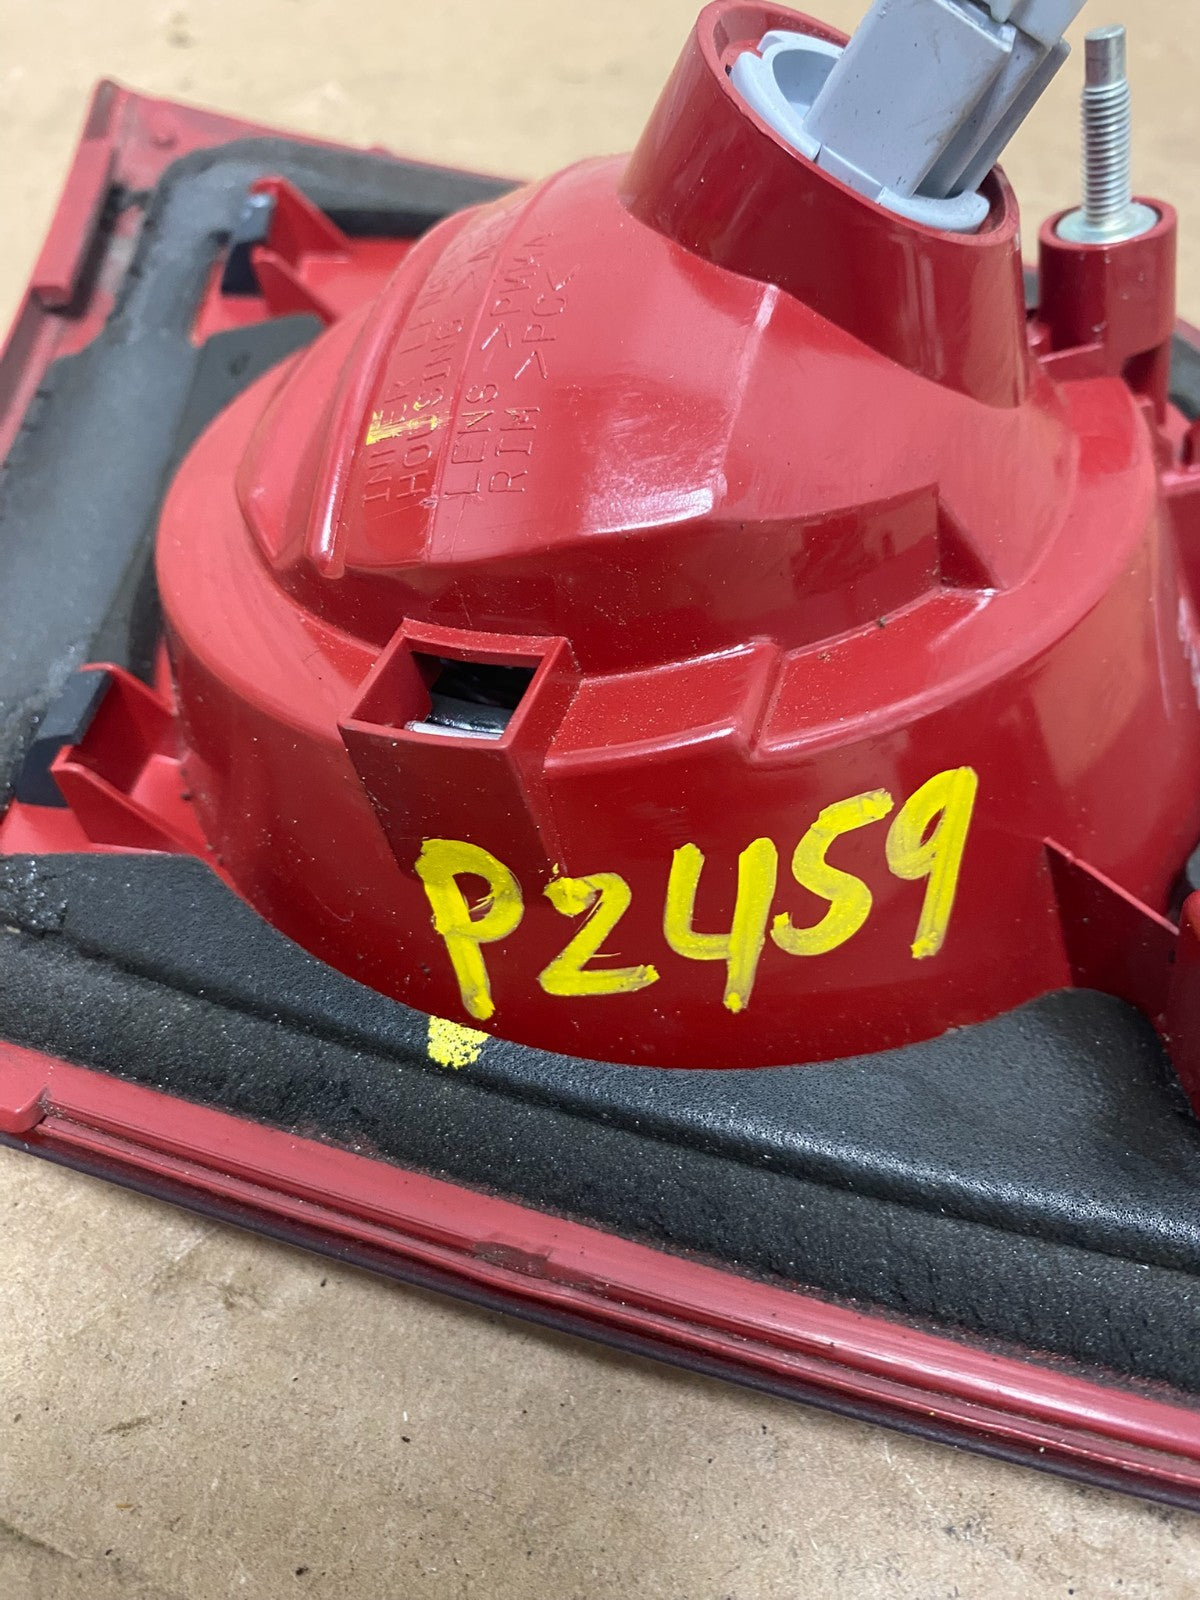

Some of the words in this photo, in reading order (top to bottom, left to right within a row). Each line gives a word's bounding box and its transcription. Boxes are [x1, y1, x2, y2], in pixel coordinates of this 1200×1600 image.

[398, 318, 464, 500] HOUSING
[444, 383, 501, 497] LENS
[489, 398, 542, 495] RIM
[415, 766, 978, 1020] P2459
